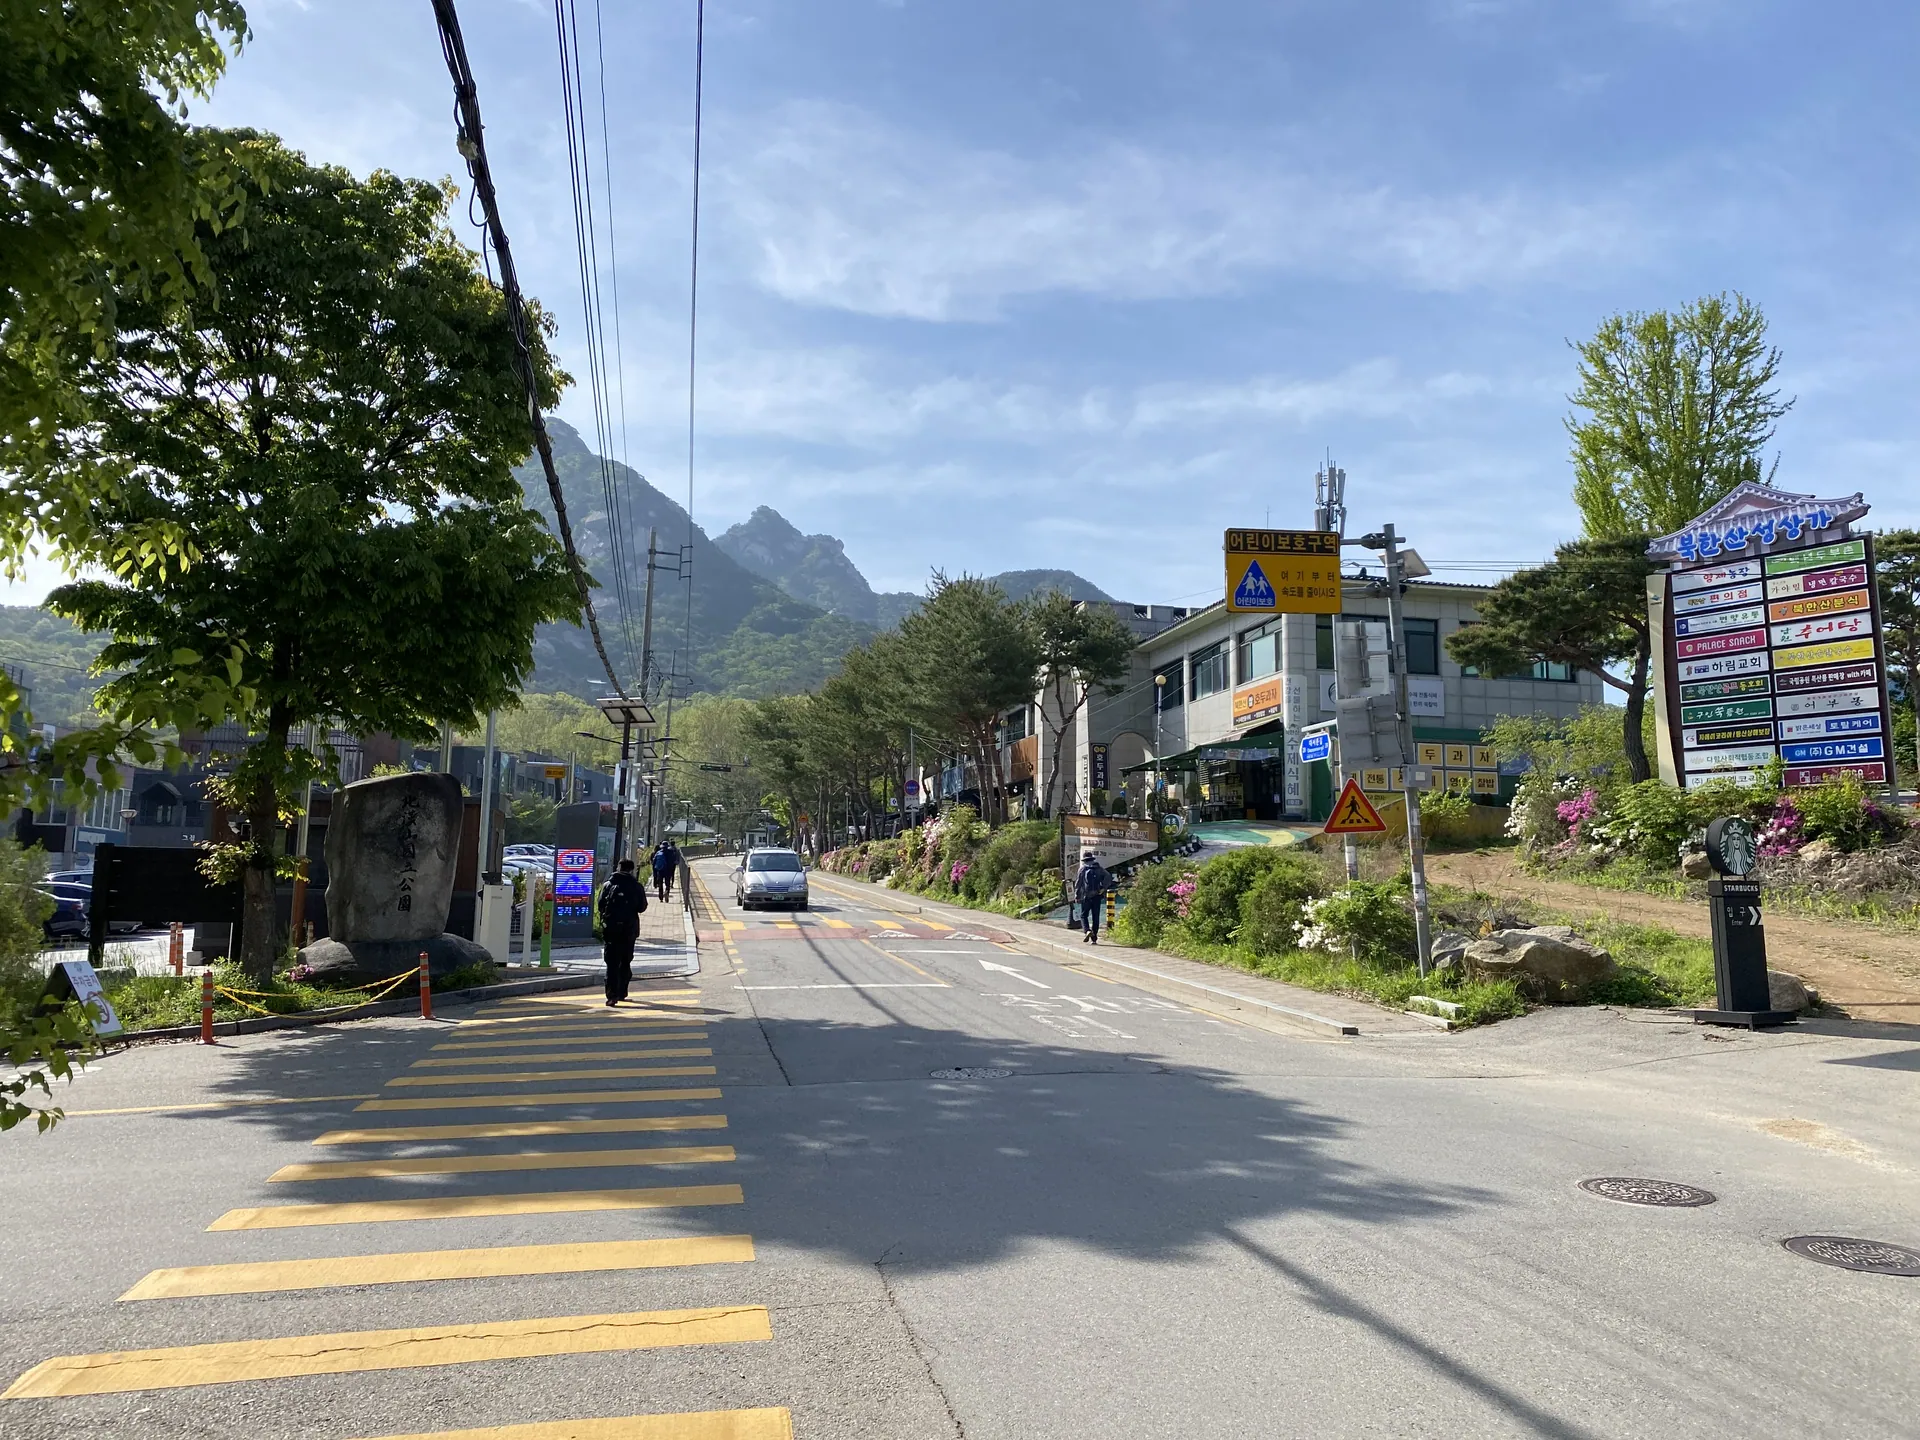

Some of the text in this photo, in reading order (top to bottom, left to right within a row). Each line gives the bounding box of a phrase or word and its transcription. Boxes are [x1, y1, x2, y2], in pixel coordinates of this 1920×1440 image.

[1230, 532, 1337, 553] 어린이보호구역
[1677, 509, 1833, 561] 북한산성상가
[1281, 586, 1336, 598] 속도를 줄이시오
[1709, 589, 1748, 603] 편의점
[1236, 597, 1274, 606] 어린이보호
[1792, 594, 1860, 614] 북한산분식
[1795, 618, 1862, 639] 추어탕
[1697, 635, 1756, 652] PALACE SNACK
[1711, 656, 1762, 673] 하림교회
[1847, 670, 1860, 679] with
[1860, 668, 1872, 678] 카페
[1254, 687, 1277, 706] 호두과자
[1829, 718, 1873, 730] 토탈케어
[1096, 753, 1104, 788] 호두과자
[1286, 737, 1300, 796] 수제식혜
[1366, 773, 1385, 784] 전통
[1477, 778, 1495, 789] 찰밥
[1727, 907, 1746, 918] 입구
[71, 974, 97, 988] 주차금지
